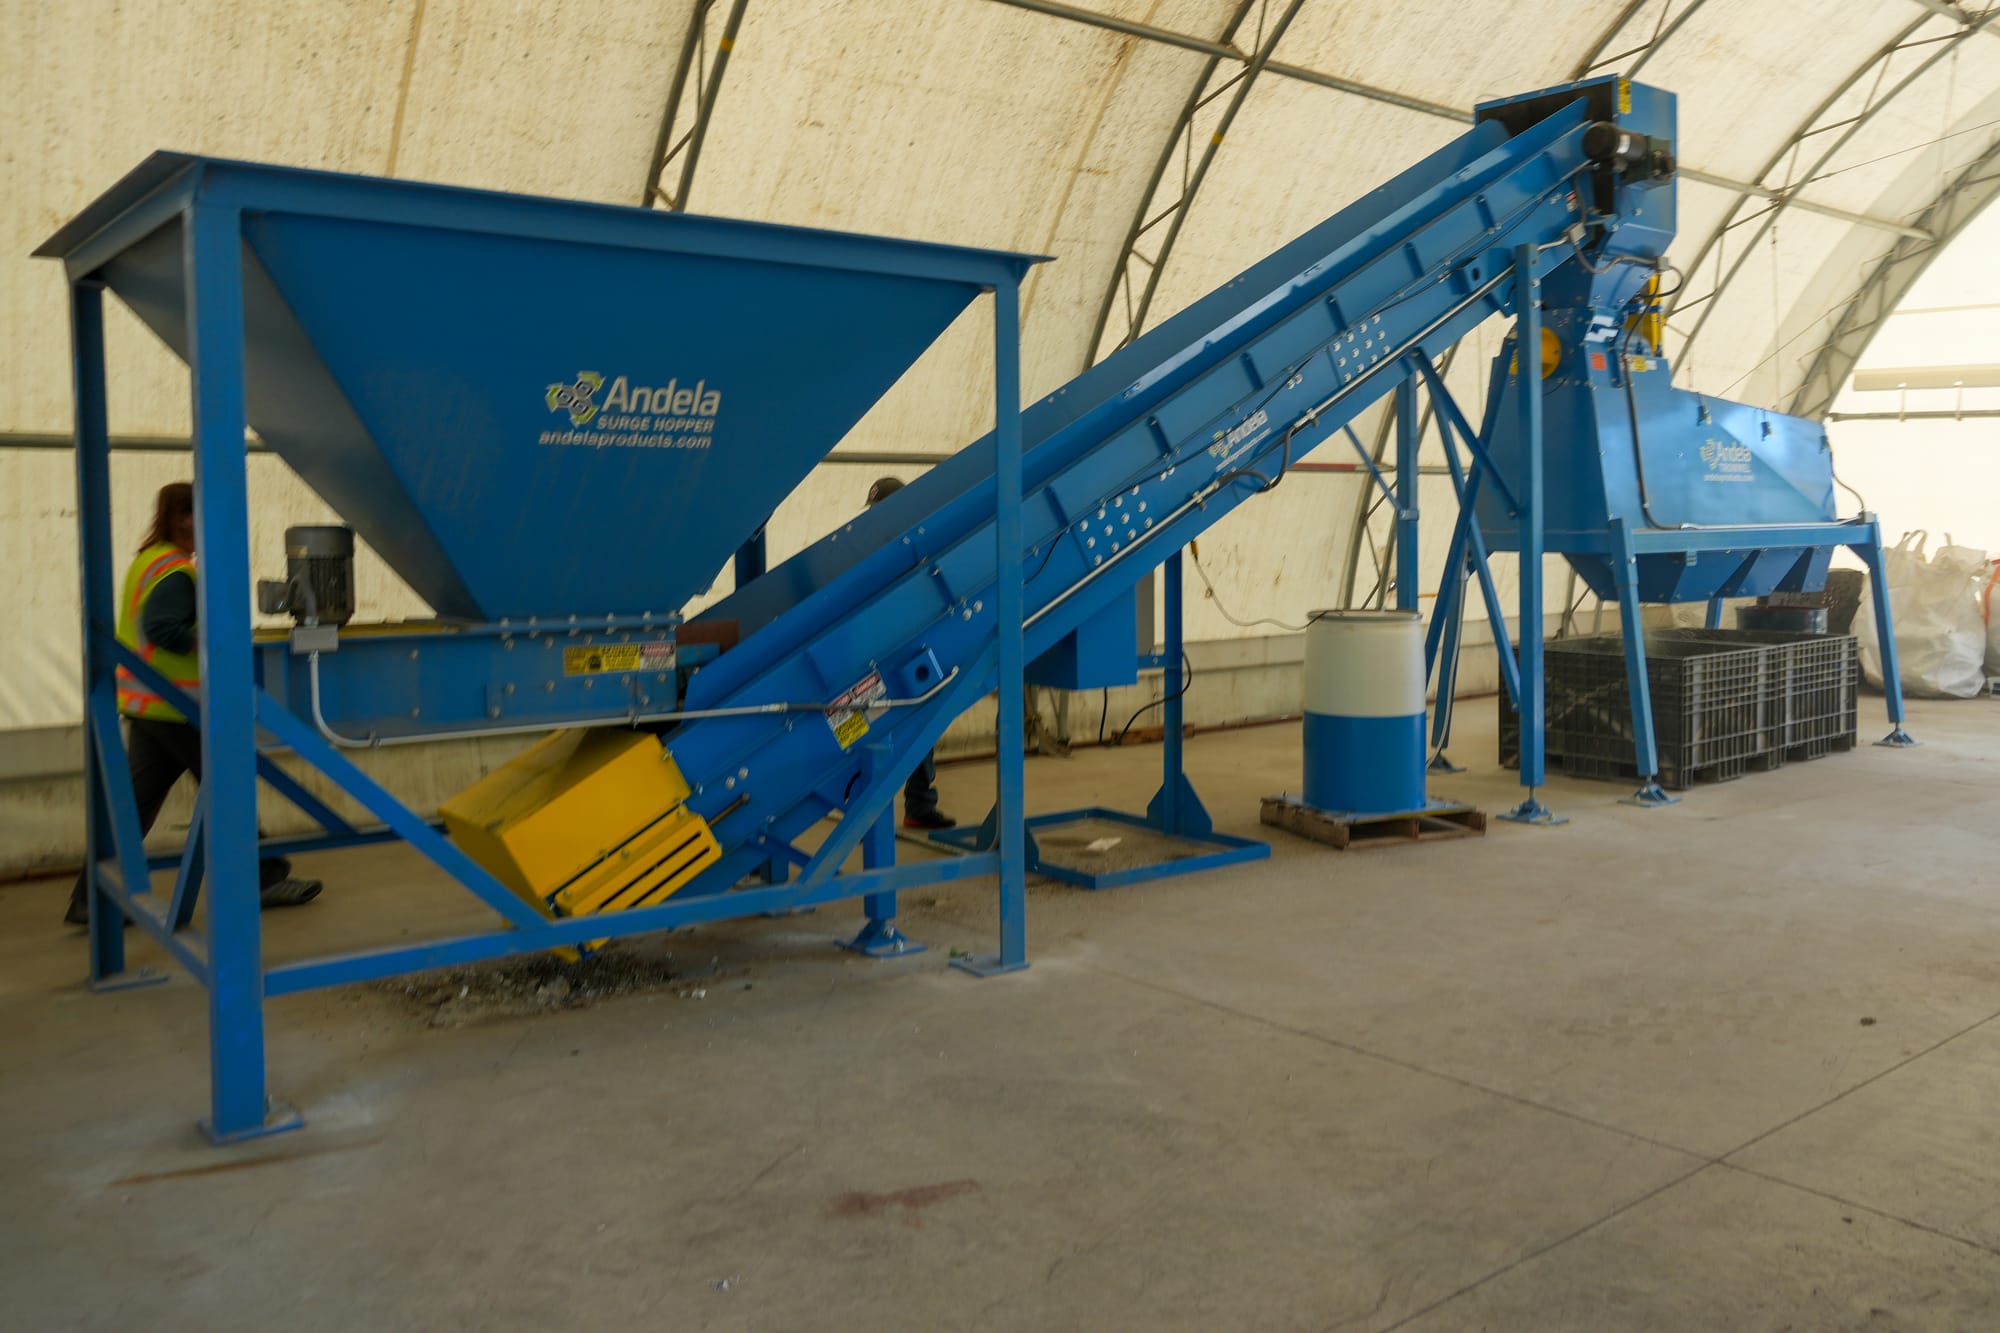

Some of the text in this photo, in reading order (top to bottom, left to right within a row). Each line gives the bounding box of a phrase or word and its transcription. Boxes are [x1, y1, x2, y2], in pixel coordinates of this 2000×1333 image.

[601, 376, 722, 416] Andela
[597, 414, 715, 433] SURGE HOPPER
[538, 430, 712, 449] andelaproducts.com
